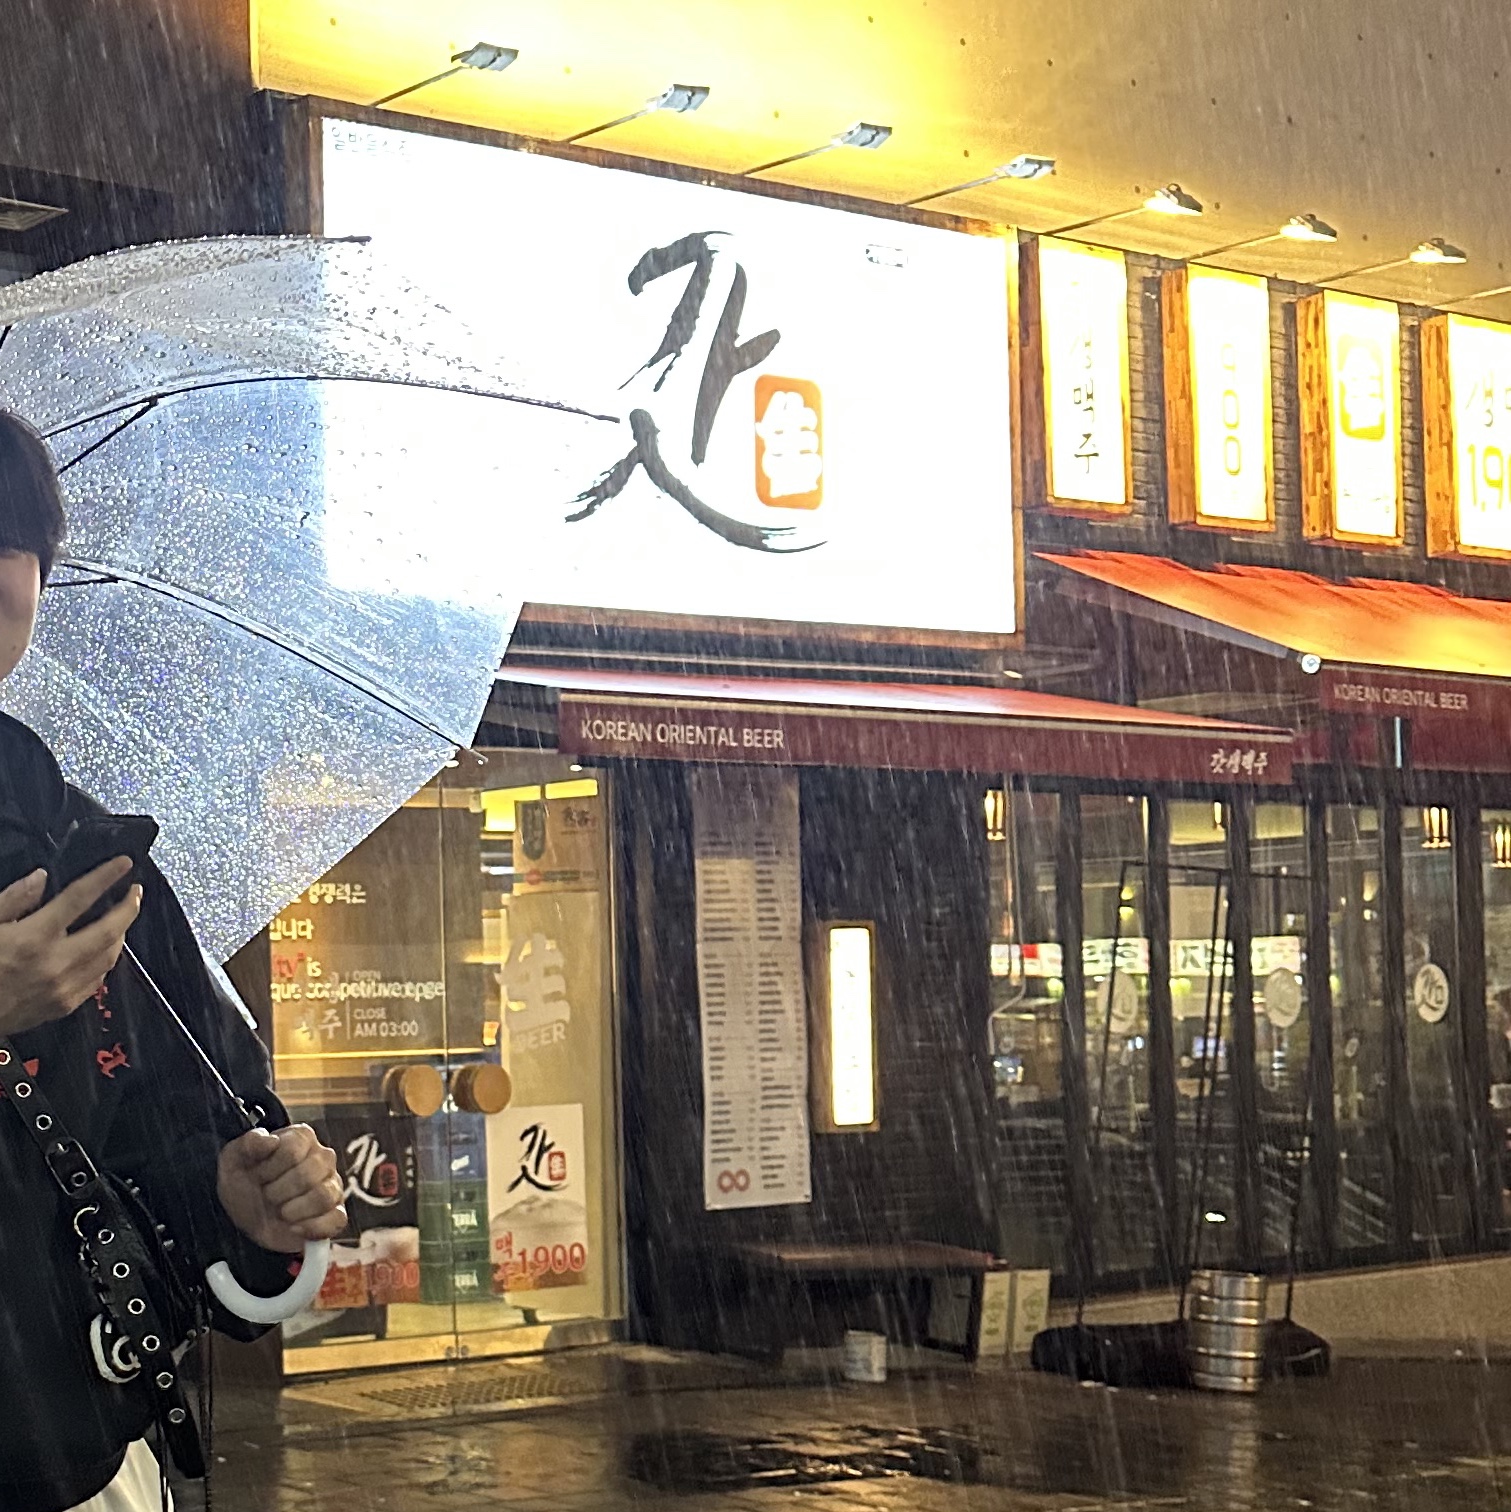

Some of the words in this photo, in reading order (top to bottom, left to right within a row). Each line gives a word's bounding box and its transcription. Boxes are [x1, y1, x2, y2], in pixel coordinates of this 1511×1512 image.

[1335, 684, 1380, 704] KOREAN
[1383, 687, 1438, 708] ORIENTAL
[1439, 692, 1469, 711] BEER
[580, 720, 652, 742] KOREAN
[656, 723, 739, 747] ORIENTAL
[742, 728, 785, 749] BEER
[307, 957, 322, 977] is
[353, 1008, 386, 1020] CLOSE
[354, 1023, 377, 1038] AM
[379, 1021, 419, 1037] 03:00
[516, 1022, 566, 1053] BEER
[518, 1242, 586, 1274] 1900
